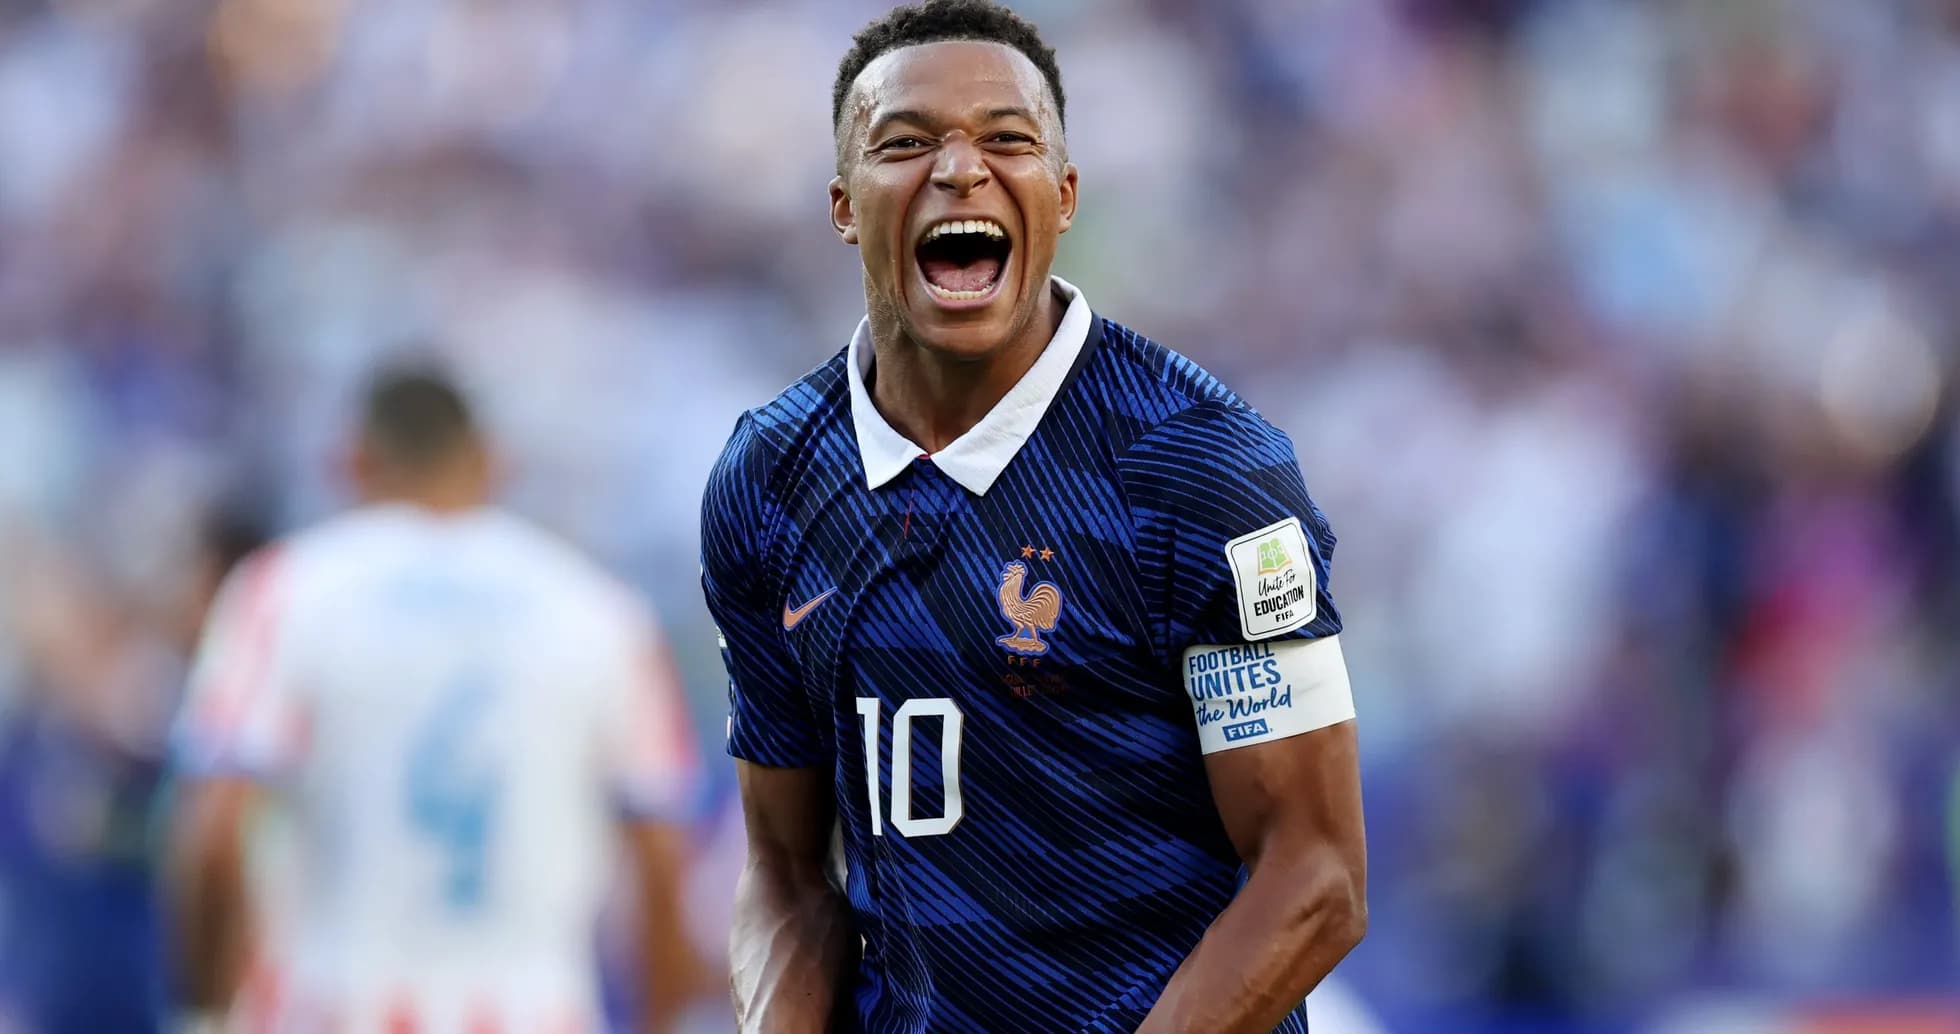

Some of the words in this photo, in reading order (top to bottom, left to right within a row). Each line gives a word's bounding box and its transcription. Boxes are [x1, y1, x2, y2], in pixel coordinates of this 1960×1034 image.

[1258, 576, 1285, 598] Unite
[1283, 568, 1297, 588] For
[1253, 585, 1305, 617] EDUCATION
[1275, 609, 1295, 623] FIFA
[1188, 642, 1276, 676] FOOTBALL
[1191, 659, 1282, 702] UNITES
[1196, 703, 1225, 727] the
[1226, 684, 1293, 720] World
[1227, 722, 1266, 739] FIFA
[855, 696, 965, 838] 10
